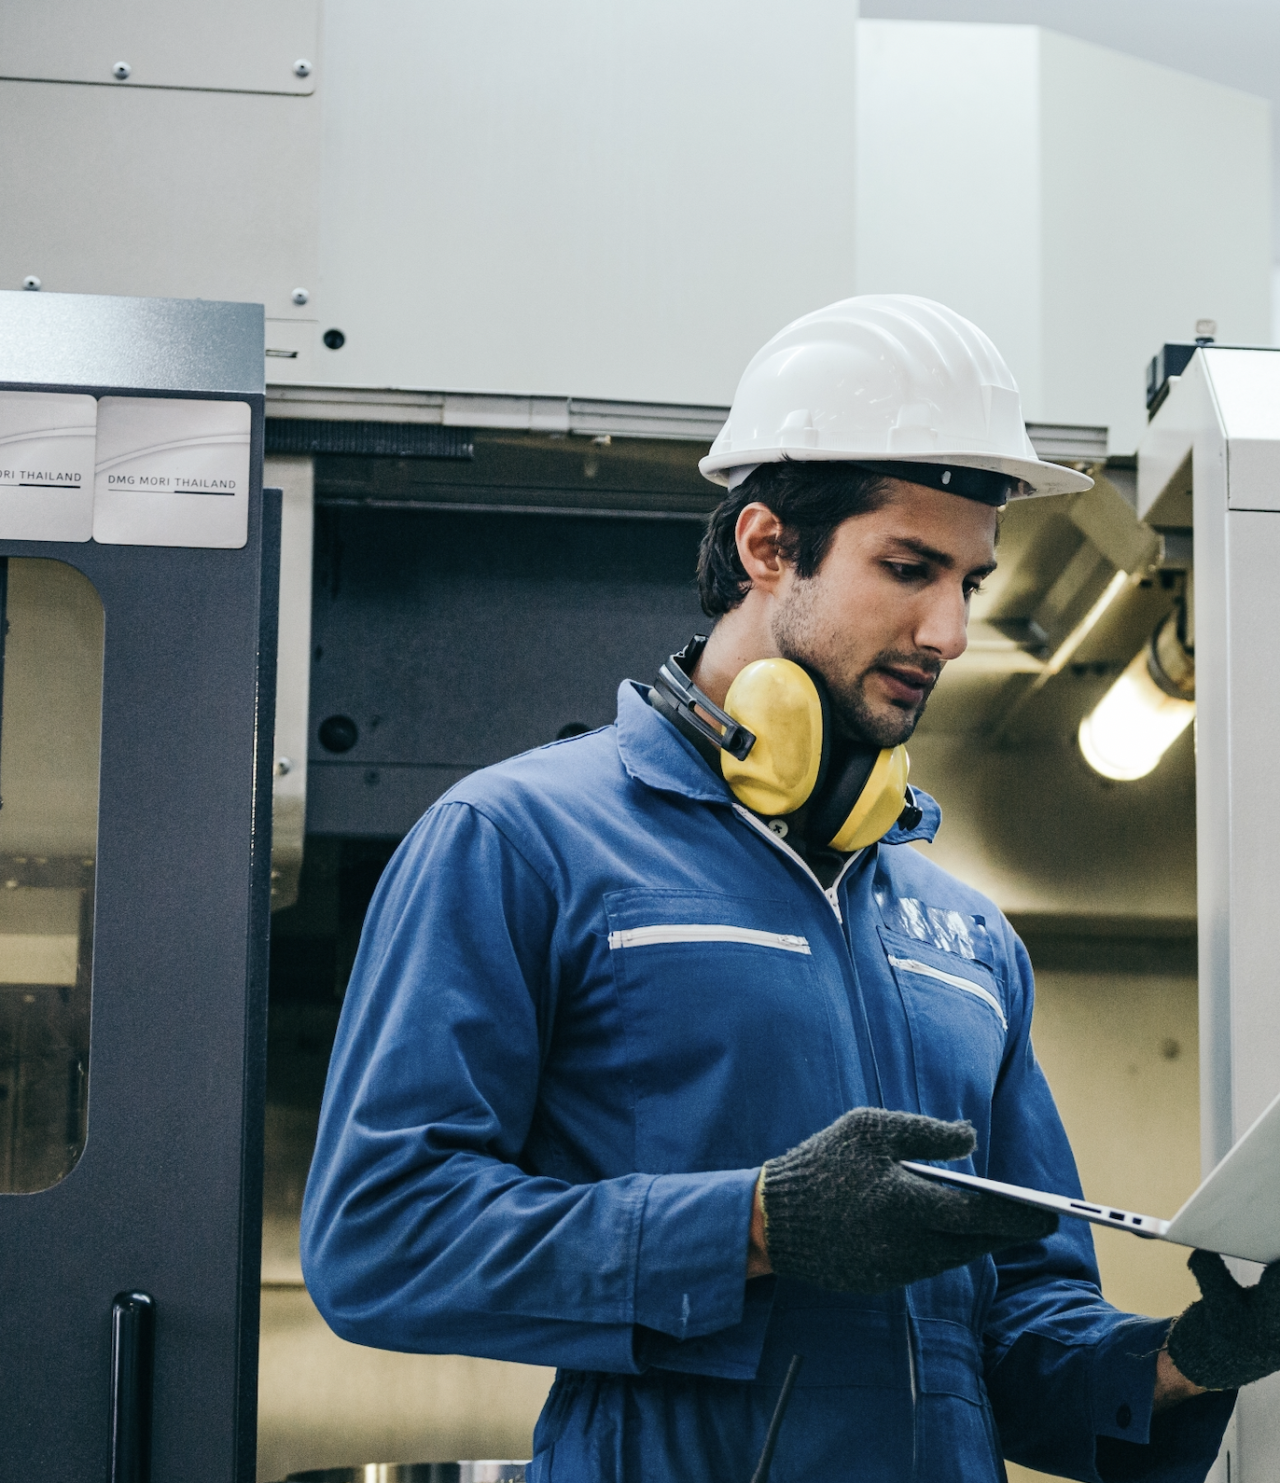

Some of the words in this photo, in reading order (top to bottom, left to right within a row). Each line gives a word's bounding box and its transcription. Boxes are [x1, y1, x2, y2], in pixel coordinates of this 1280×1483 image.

[19, 470, 82, 482] THAILAND
[108, 474, 135, 485] DMG
[140, 476, 170, 487] MORI
[175, 478, 236, 489] THAILAND
